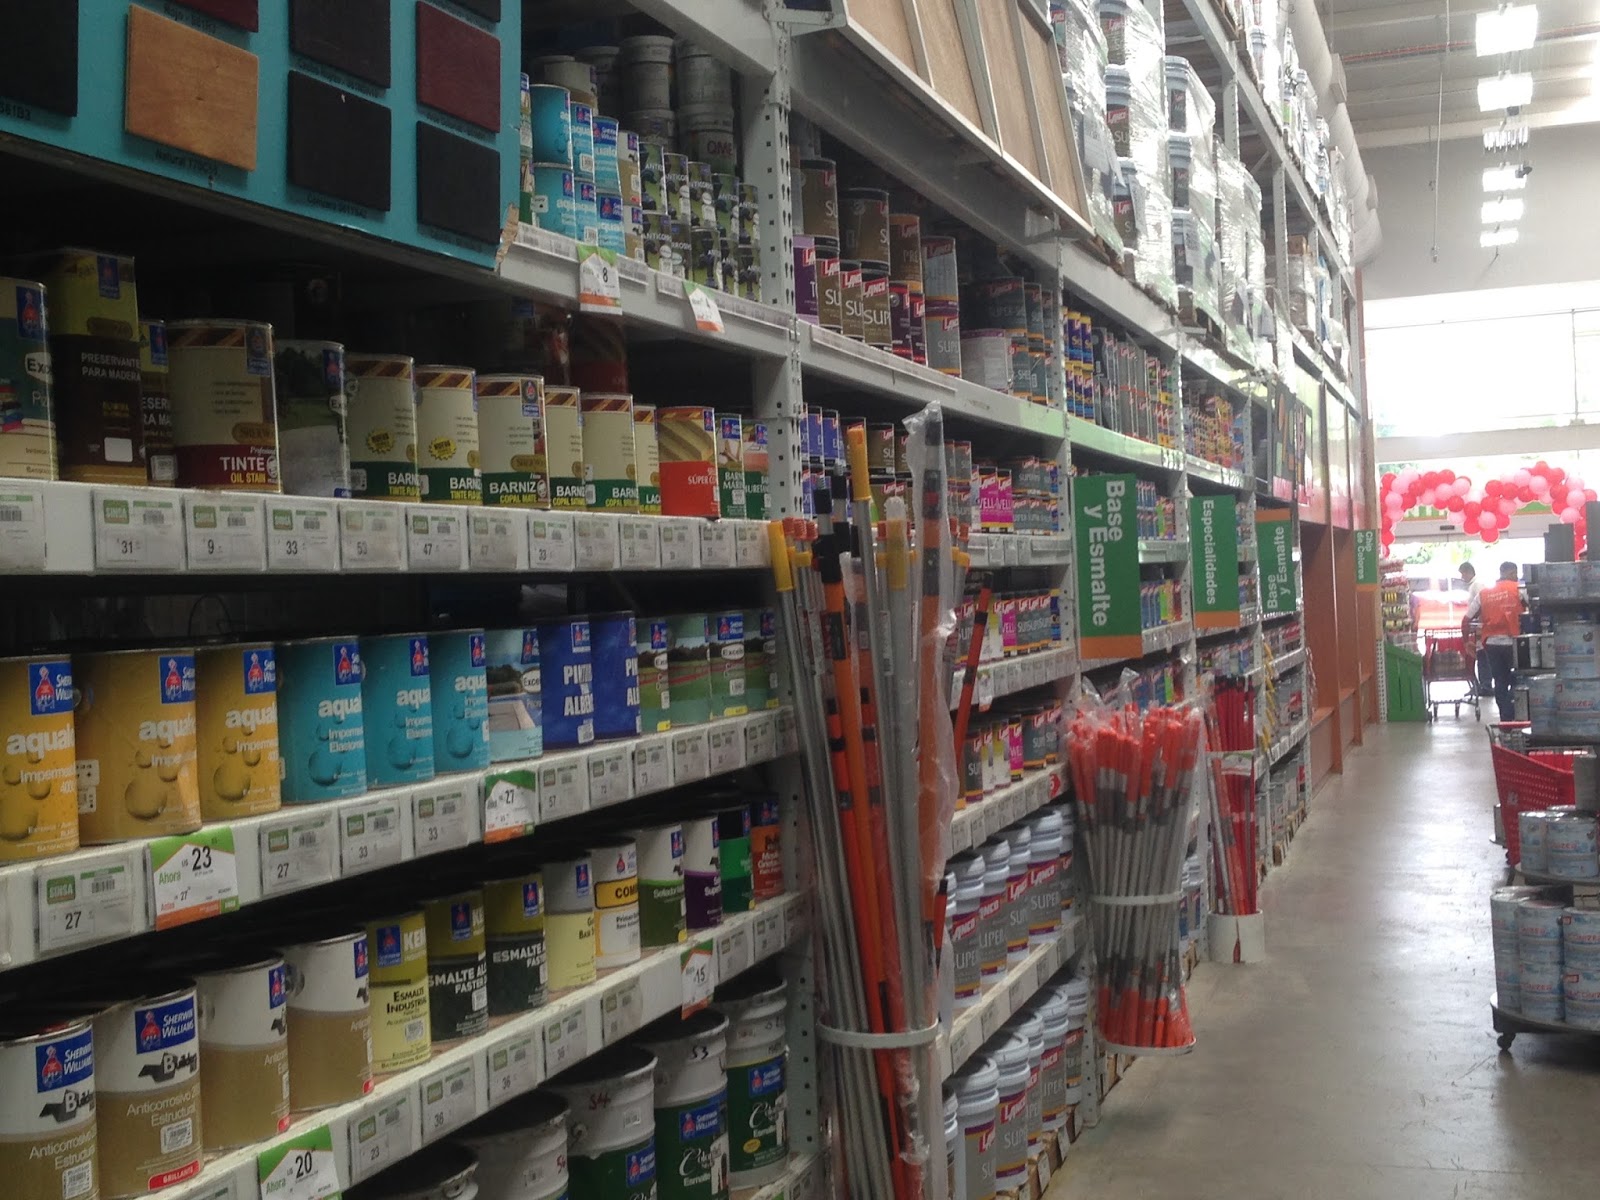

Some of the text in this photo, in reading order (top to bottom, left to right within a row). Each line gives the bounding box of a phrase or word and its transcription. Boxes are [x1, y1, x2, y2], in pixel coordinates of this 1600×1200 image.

[81, 352, 141, 367] PRESERVANTE
[81, 366, 141, 382] PARA MADERA
[219, 455, 266, 473] TINTE
[230, 472, 267, 485] OIL STAIN
[489, 480, 537, 495] BARNIZ
[1105, 479, 1127, 542] Base
[120, 539, 134, 554] 31
[207, 539, 215, 554] 9
[285, 540, 298, 555] 33
[423, 543, 433, 556] 47
[1365, 530, 1374, 553] Chip
[1200, 499, 1219, 606] Especialidades
[1273, 525, 1292, 597] y Esmalte
[1356, 531, 1366, 581] de Colores
[1083, 504, 1112, 627] y Esmalte
[1267, 573, 1279, 610] Base
[504, 788, 515, 805] 27
[427, 826, 439, 841] 33
[191, 845, 213, 872] 23
[358, 845, 369, 860] 33
[158, 870, 182, 885] Ahora
[277, 863, 290, 878] 27
[64, 911, 82, 930] 27
[492, 945, 540, 964] ESMALTE
[393, 986, 425, 1002] ESMALTE
[162, 1008, 194, 1027] SHERWIN
[161, 1021, 195, 1039] WILLIAMS
[126, 1091, 192, 1117] Anticorrosivo
[151, 1103, 197, 1128] Estructural
[370, 1146, 380, 1160] 23
[294, 1150, 313, 1179] 20
[162, 1165, 195, 1185] BRILLANTE
[265, 1178, 286, 1195] Ahora
